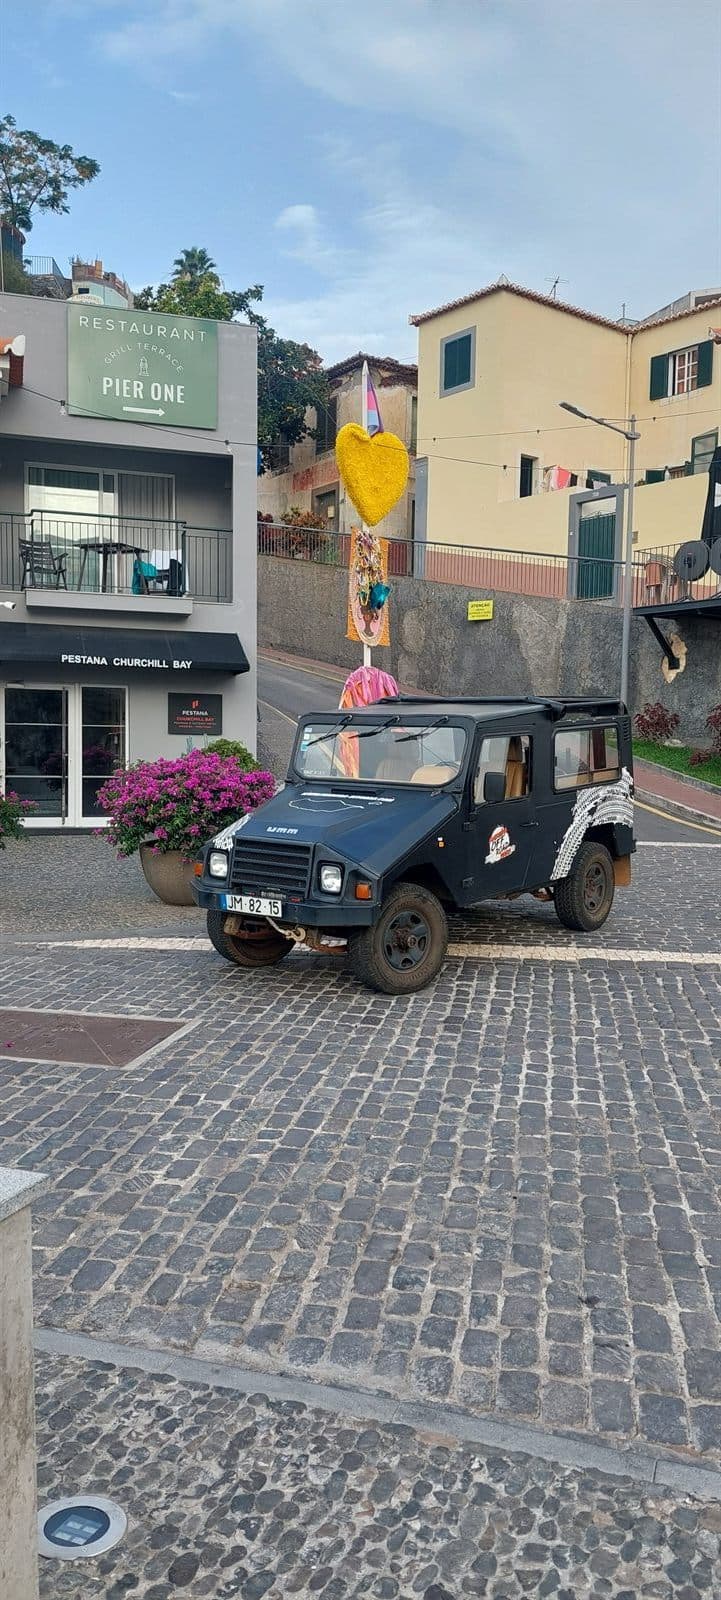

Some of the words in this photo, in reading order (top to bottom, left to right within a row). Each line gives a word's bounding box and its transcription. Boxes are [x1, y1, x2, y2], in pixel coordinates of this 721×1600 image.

[79, 316, 206, 342] RESTAURANT
[104, 344, 132, 364] GRILL
[137, 342, 184, 372] TERRACE
[102, 377, 144, 399] PIER
[151, 383, 185, 403] ONE
[61, 654, 108, 665] PESTANA
[113, 658, 169, 668] CHURCHILL
[173, 660, 193, 669] BAY
